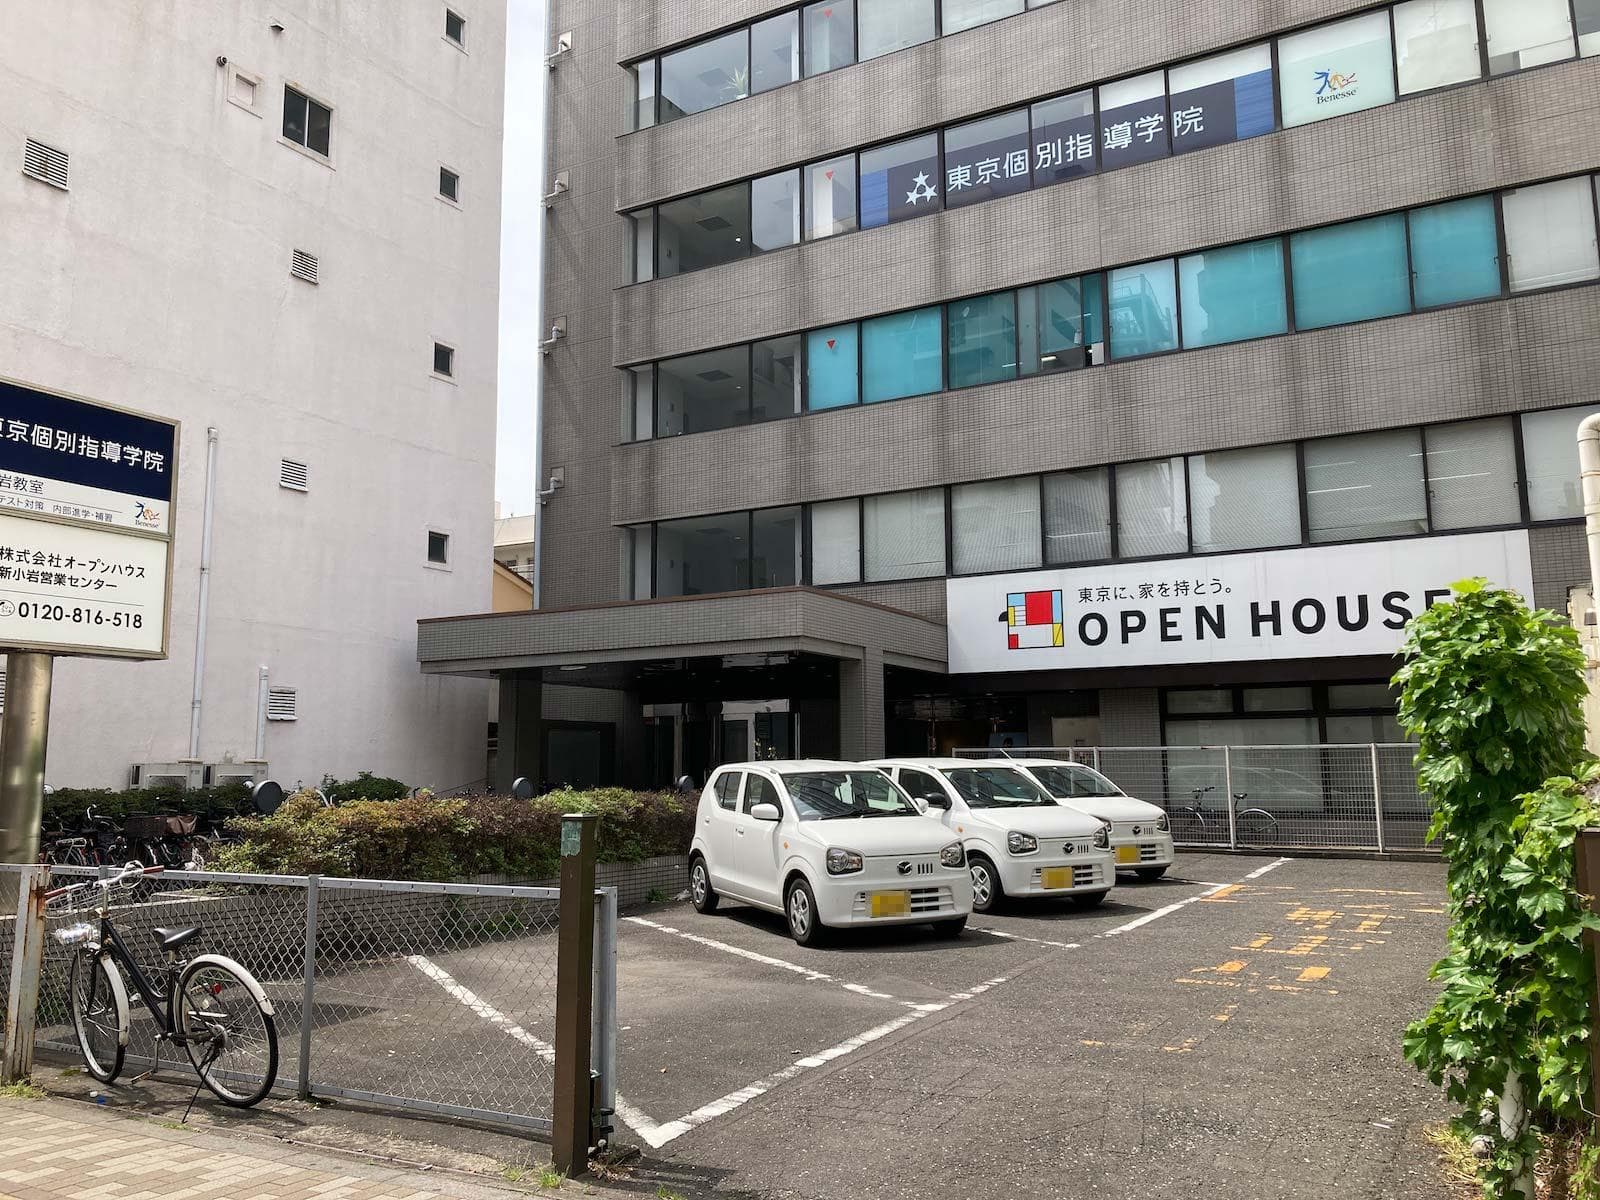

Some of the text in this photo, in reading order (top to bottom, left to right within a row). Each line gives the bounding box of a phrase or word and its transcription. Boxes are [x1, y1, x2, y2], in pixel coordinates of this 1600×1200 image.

[1316, 88, 1357, 104] Benesse
[947, 107, 1204, 191] 東京個別指導学院
[0, 418, 164, 472] 京個別指導学院
[0, 473, 44, 495] 岩教室
[0, 546, 145, 578] 株式会社オープンハウス
[0, 566, 118, 590] 新小岩営業センター
[1078, 578, 1233, 604] 東京に、家を持とう。
[18, 601, 143, 630] 0120-816-518
[1078, 604, 1226, 648] OPEN
